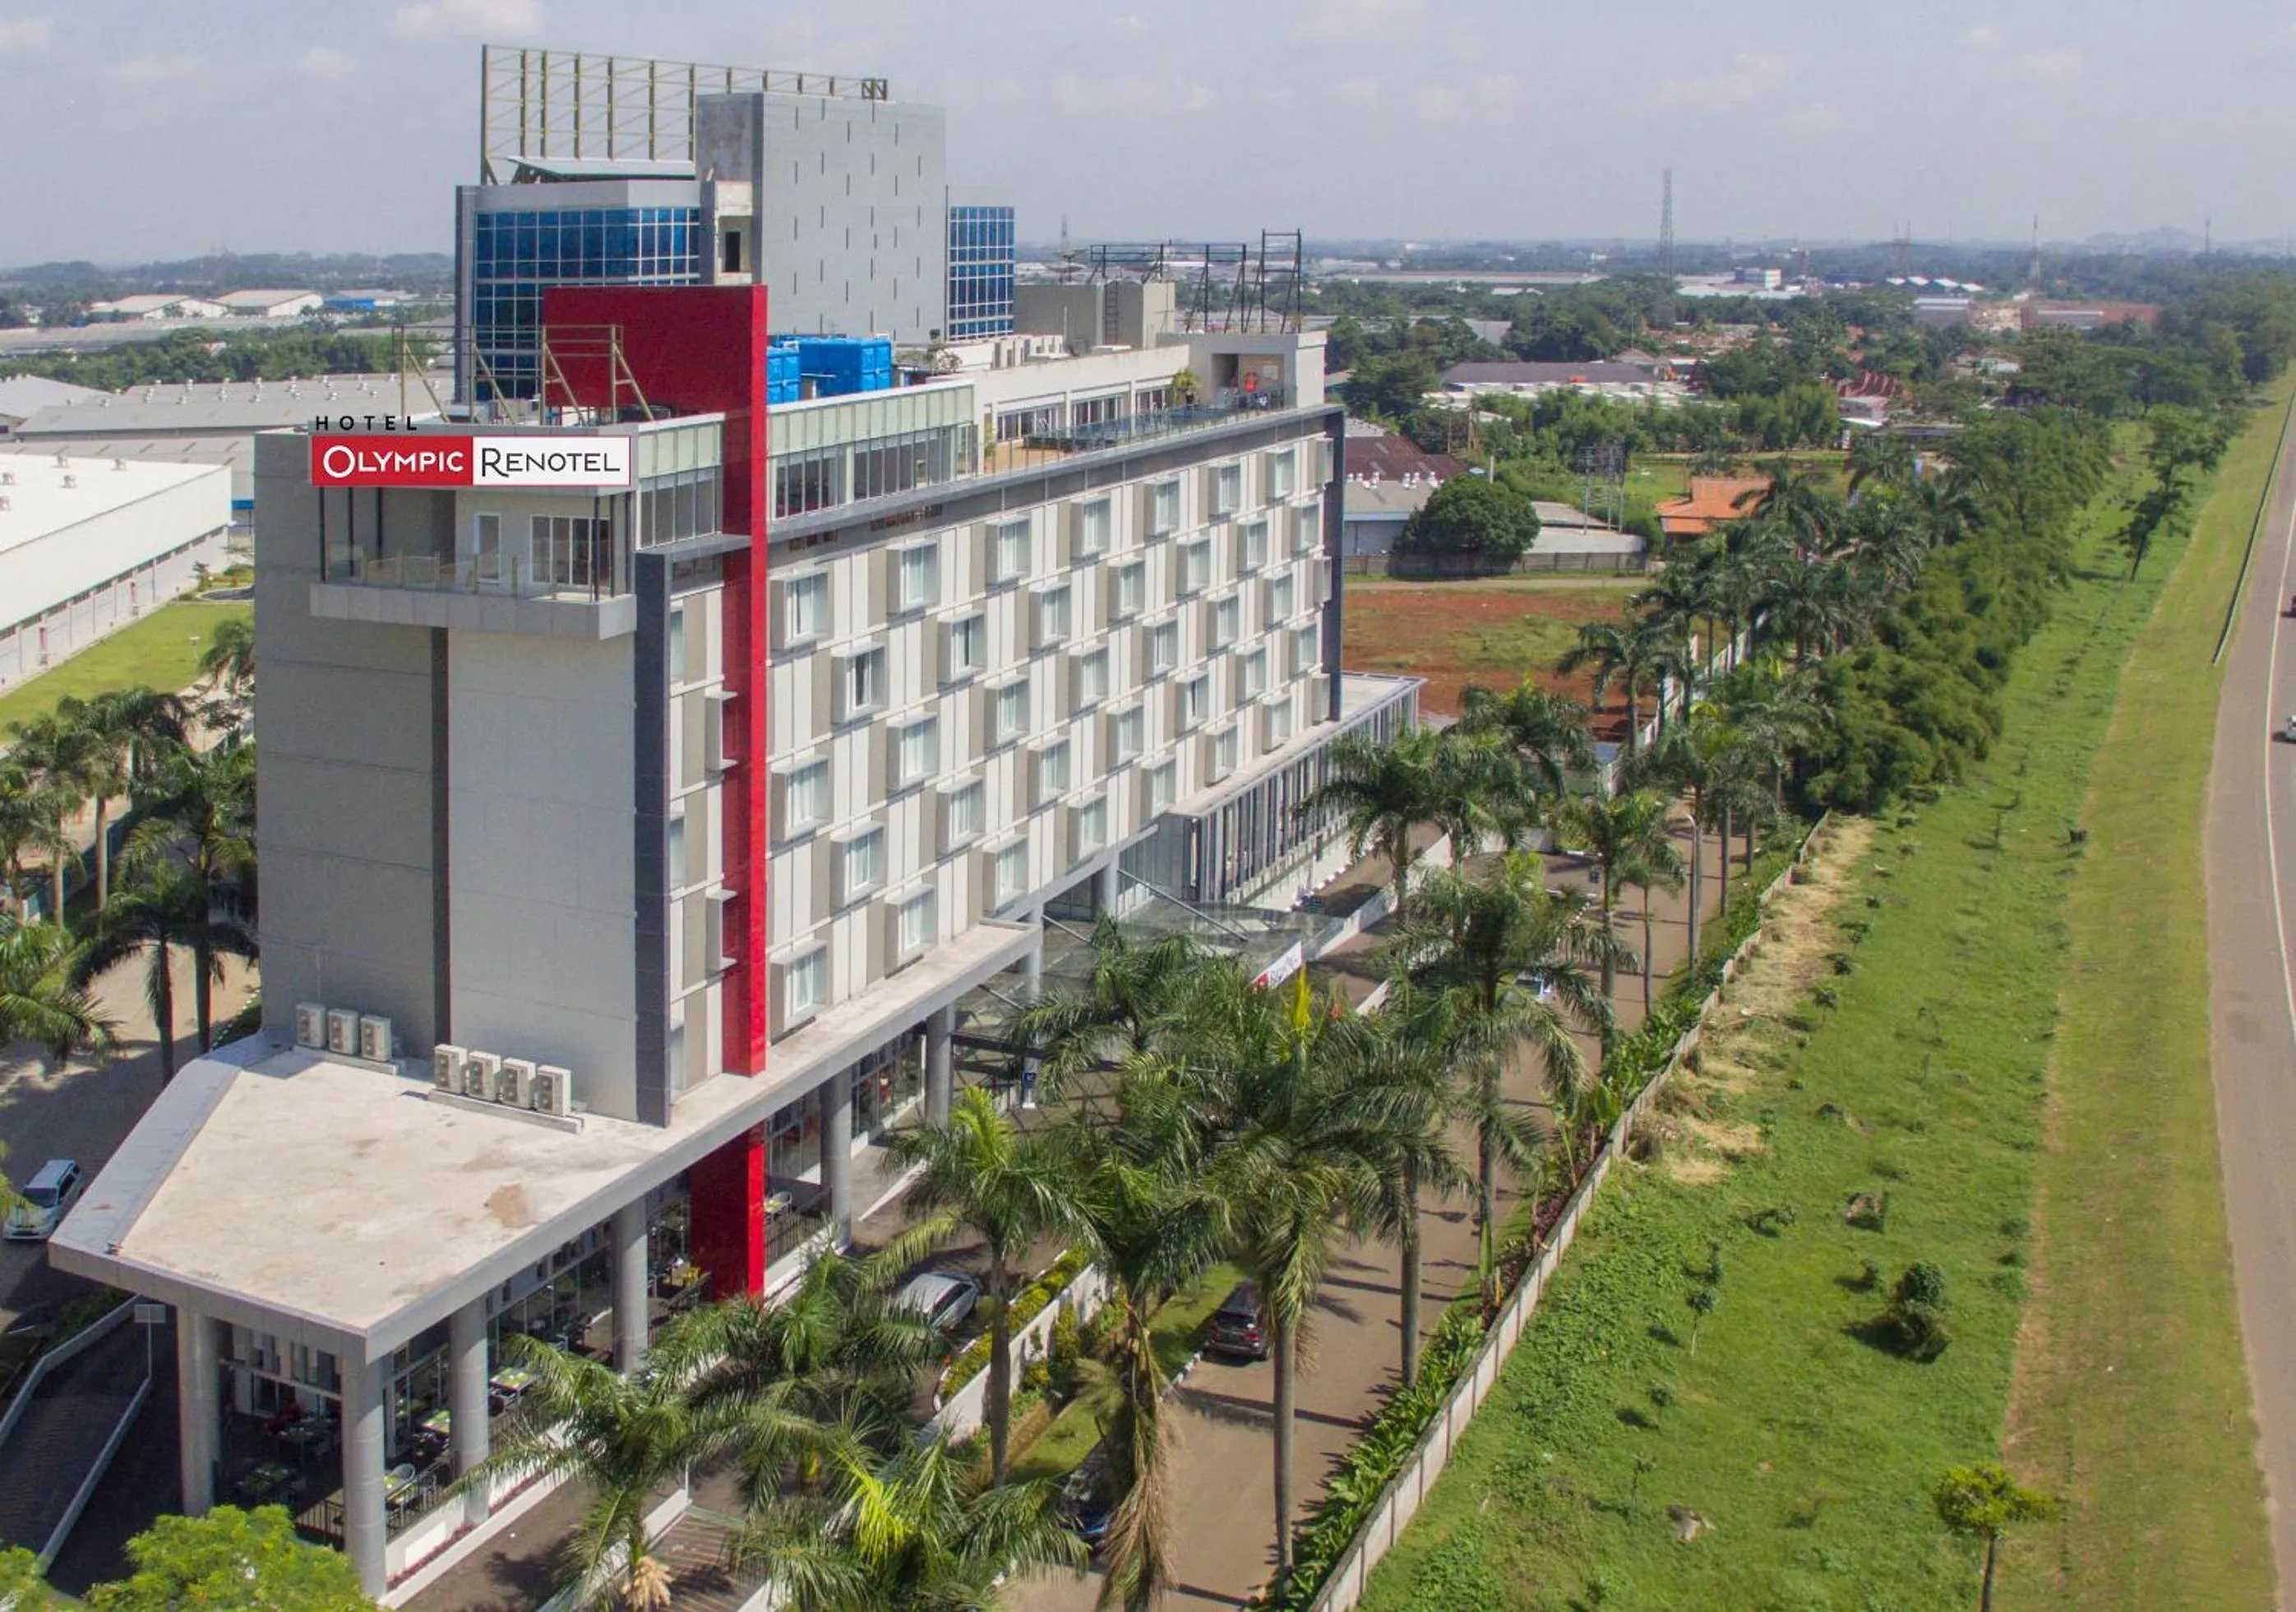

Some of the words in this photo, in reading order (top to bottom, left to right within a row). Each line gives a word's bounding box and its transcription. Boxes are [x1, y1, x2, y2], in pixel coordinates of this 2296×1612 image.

[316, 415, 417, 431] HOTEL
[322, 445, 464, 478] OLYMPIC
[481, 447, 621, 478] RENOTEL
